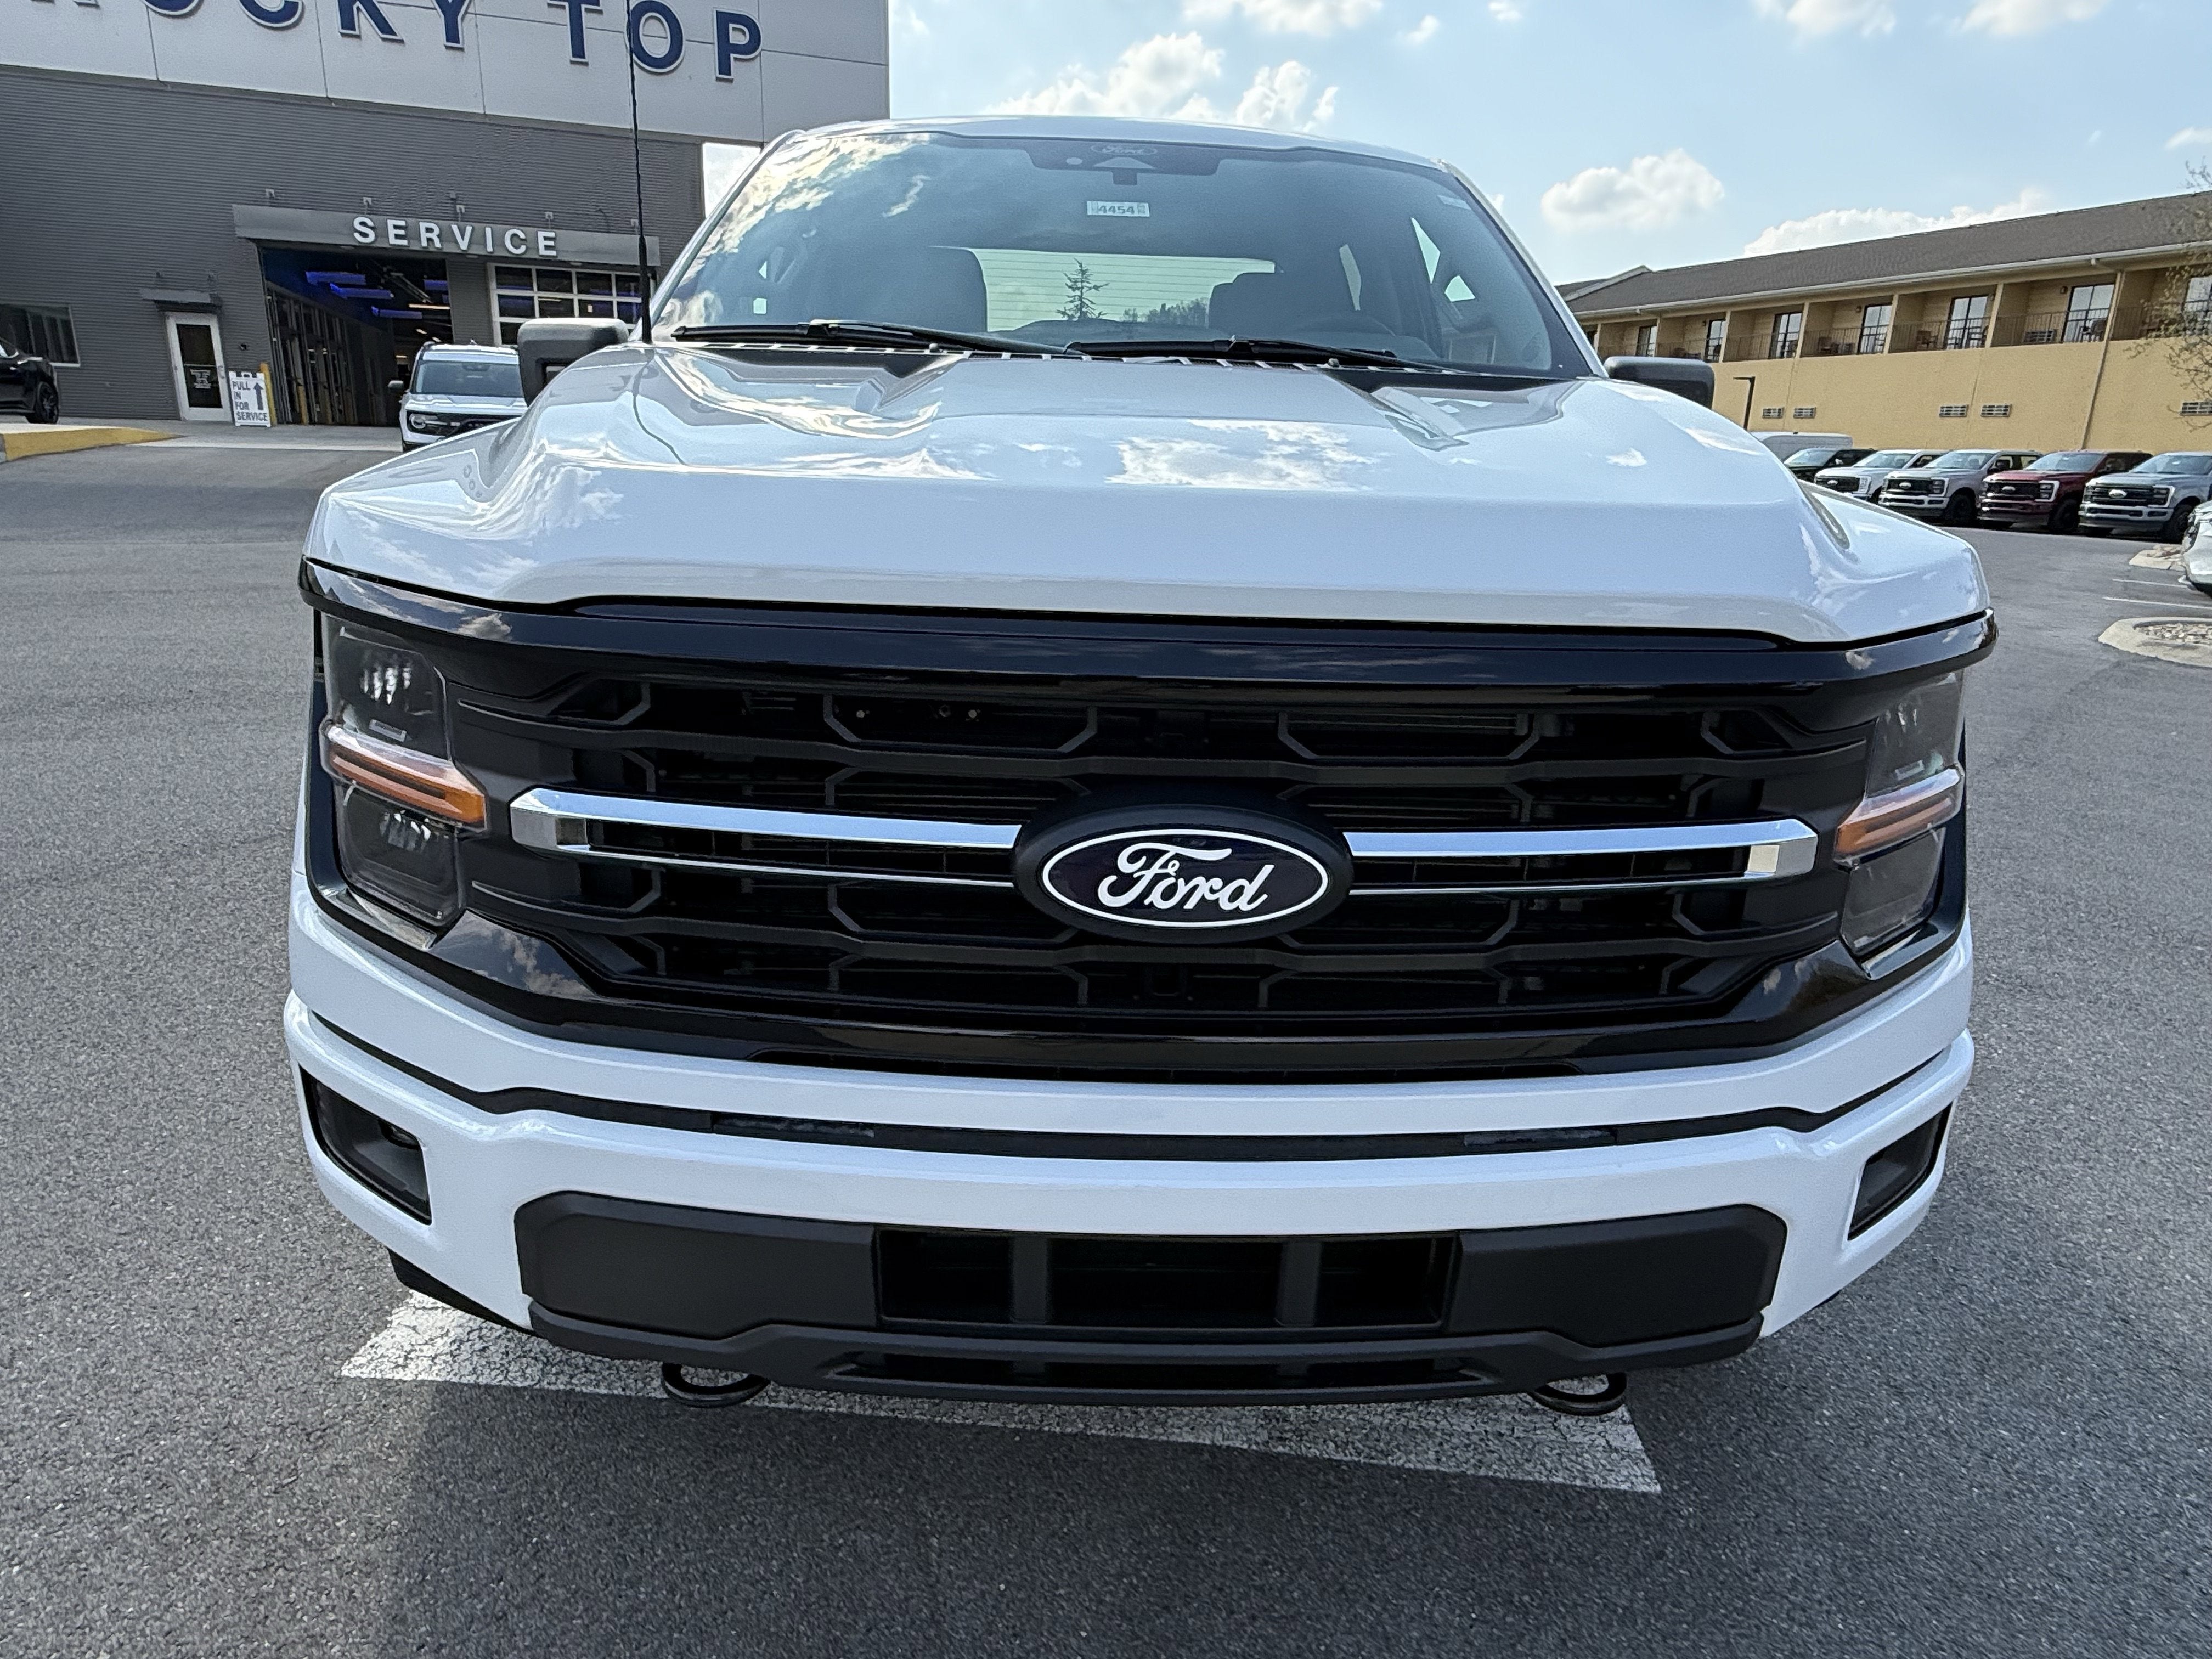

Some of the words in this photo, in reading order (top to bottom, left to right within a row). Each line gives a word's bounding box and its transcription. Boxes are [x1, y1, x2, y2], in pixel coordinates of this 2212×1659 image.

[548, 0, 761, 80] TOP
[1098, 205, 1134, 214] 4454
[353, 216, 556, 256] SERVICE
[232, 381, 250, 391] PULL
[234, 391, 241, 400] IN
[235, 402, 250, 410] FOR
[236, 411, 268, 421] SERVICE
[1097, 842, 1276, 912] Ford
